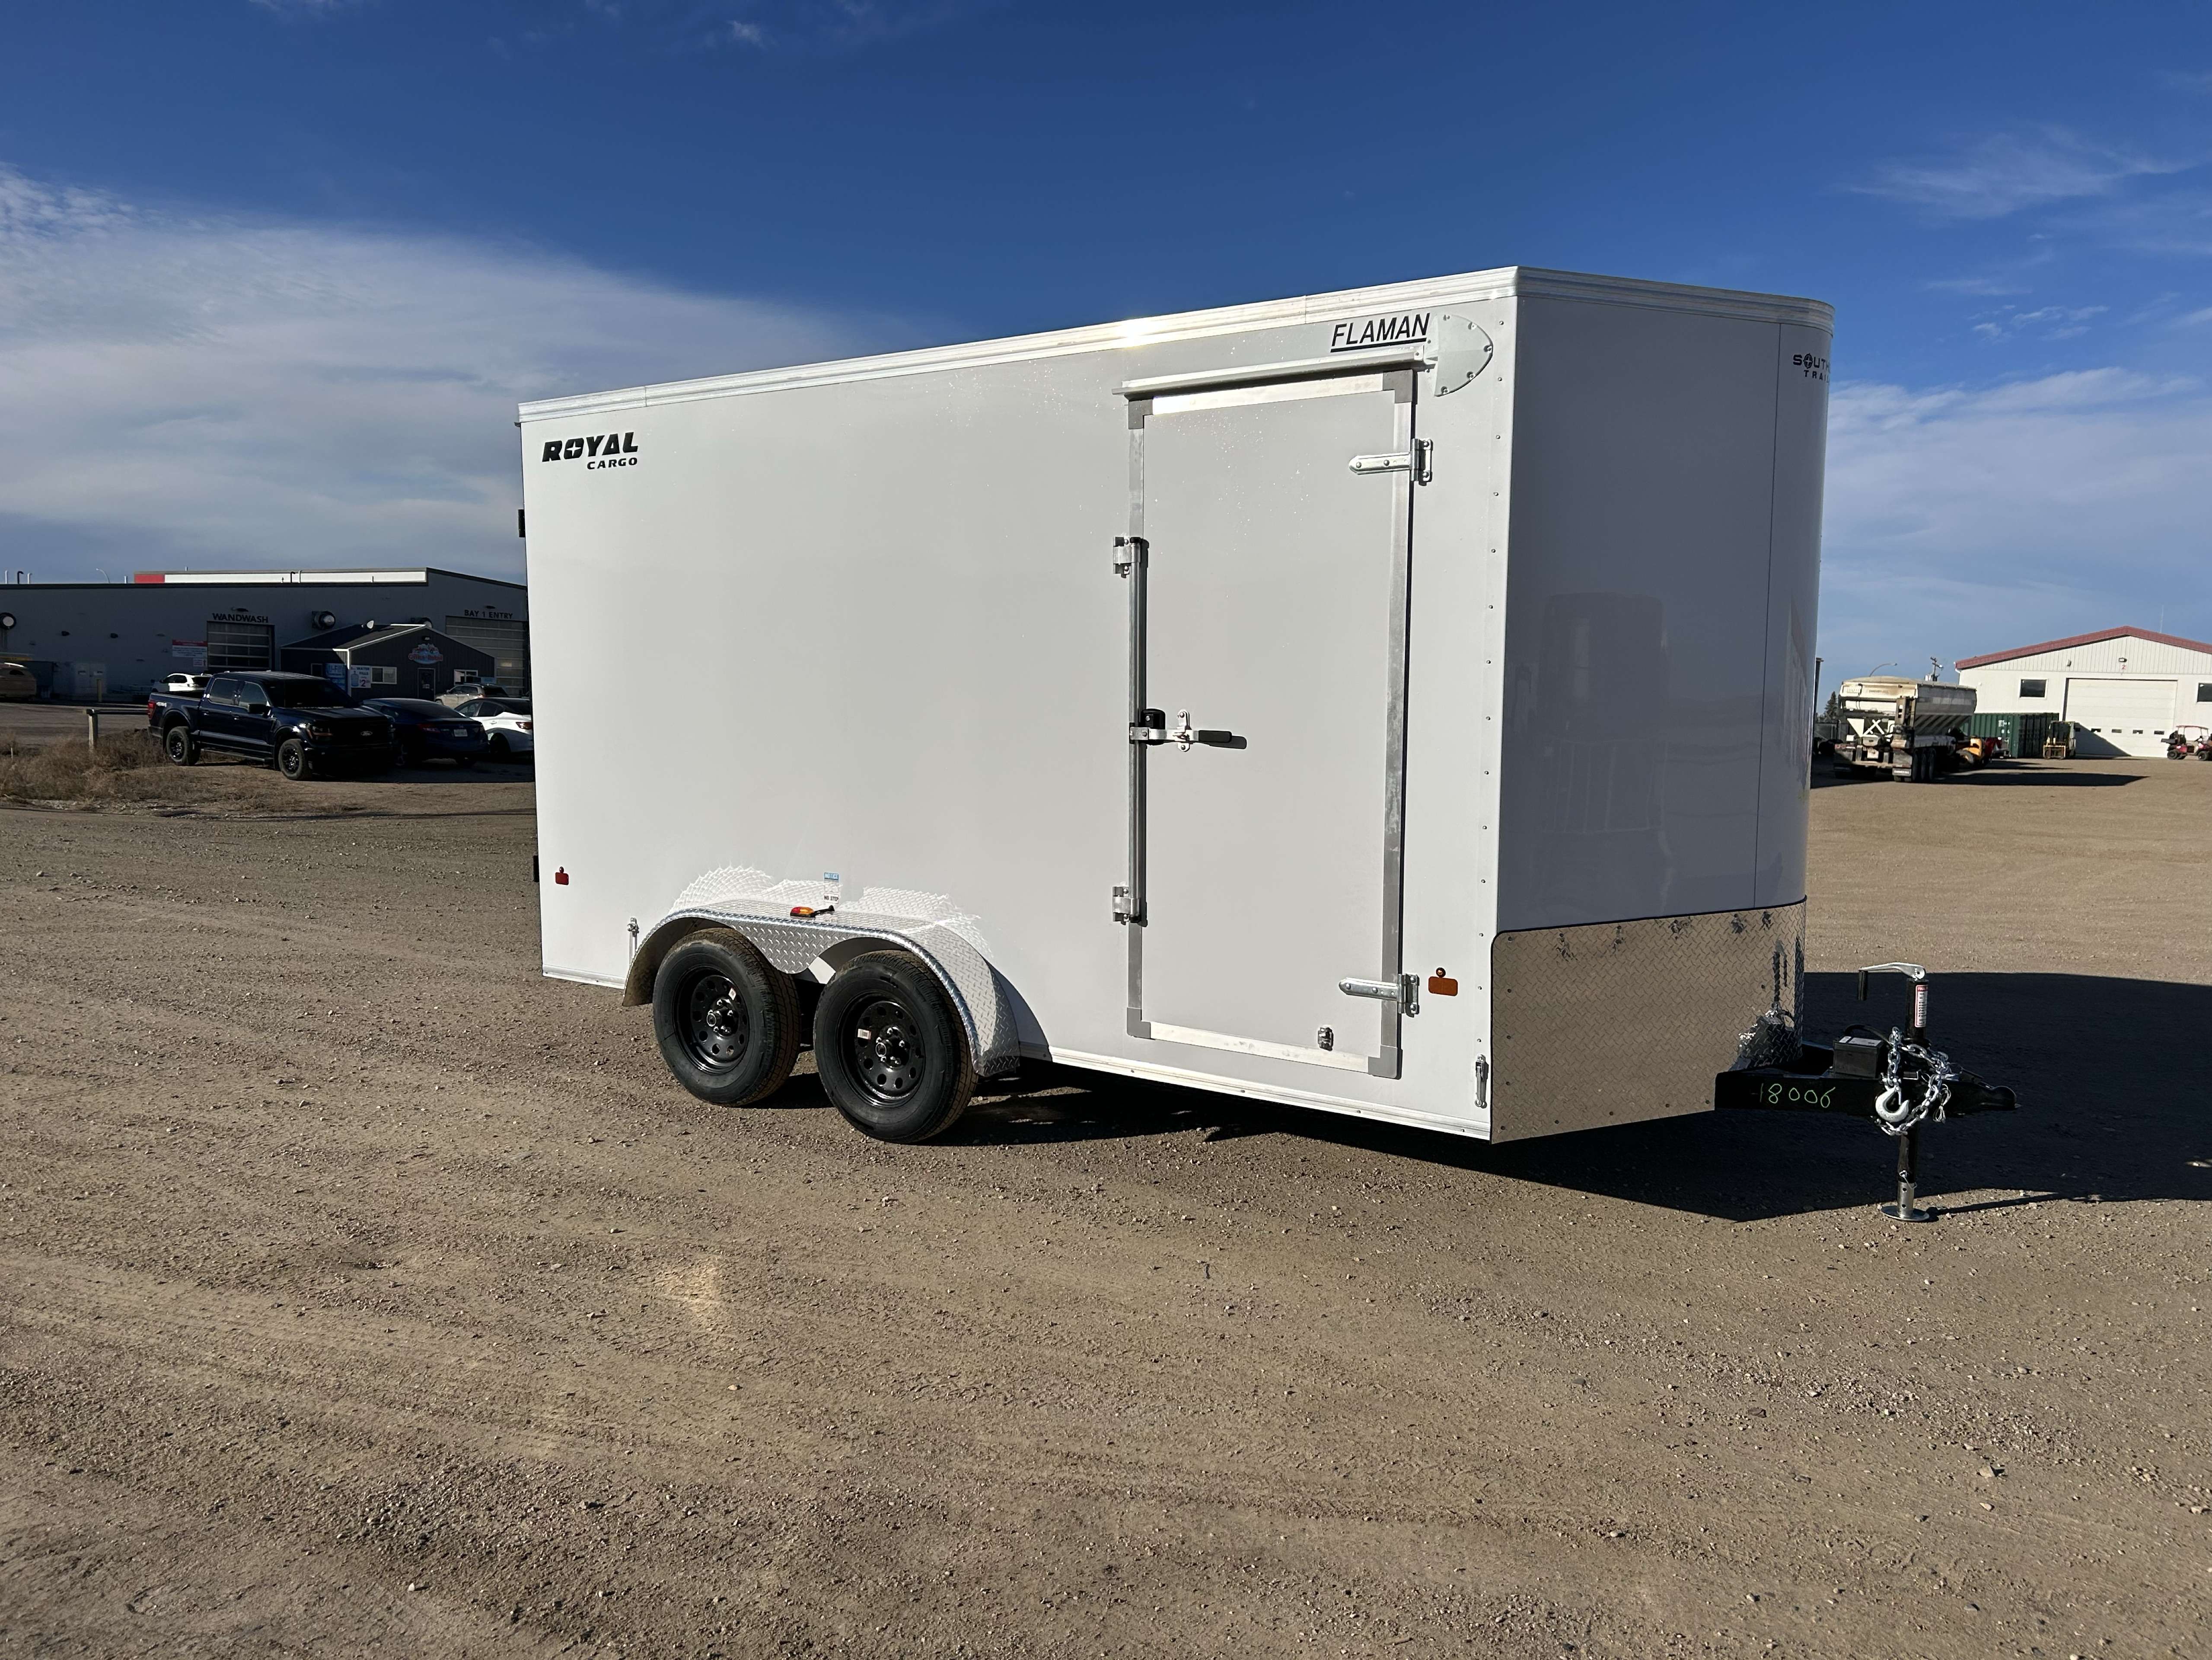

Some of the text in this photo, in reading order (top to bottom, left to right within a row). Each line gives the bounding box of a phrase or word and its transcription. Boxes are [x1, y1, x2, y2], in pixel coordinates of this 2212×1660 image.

[1332, 312, 1430, 347] FLAMAN
[542, 431, 638, 462] ROYAL
[587, 457, 638, 470] CARGO
[212, 613, 269, 623] WANDWASH
[1759, 1082, 1836, 1108] 18006
